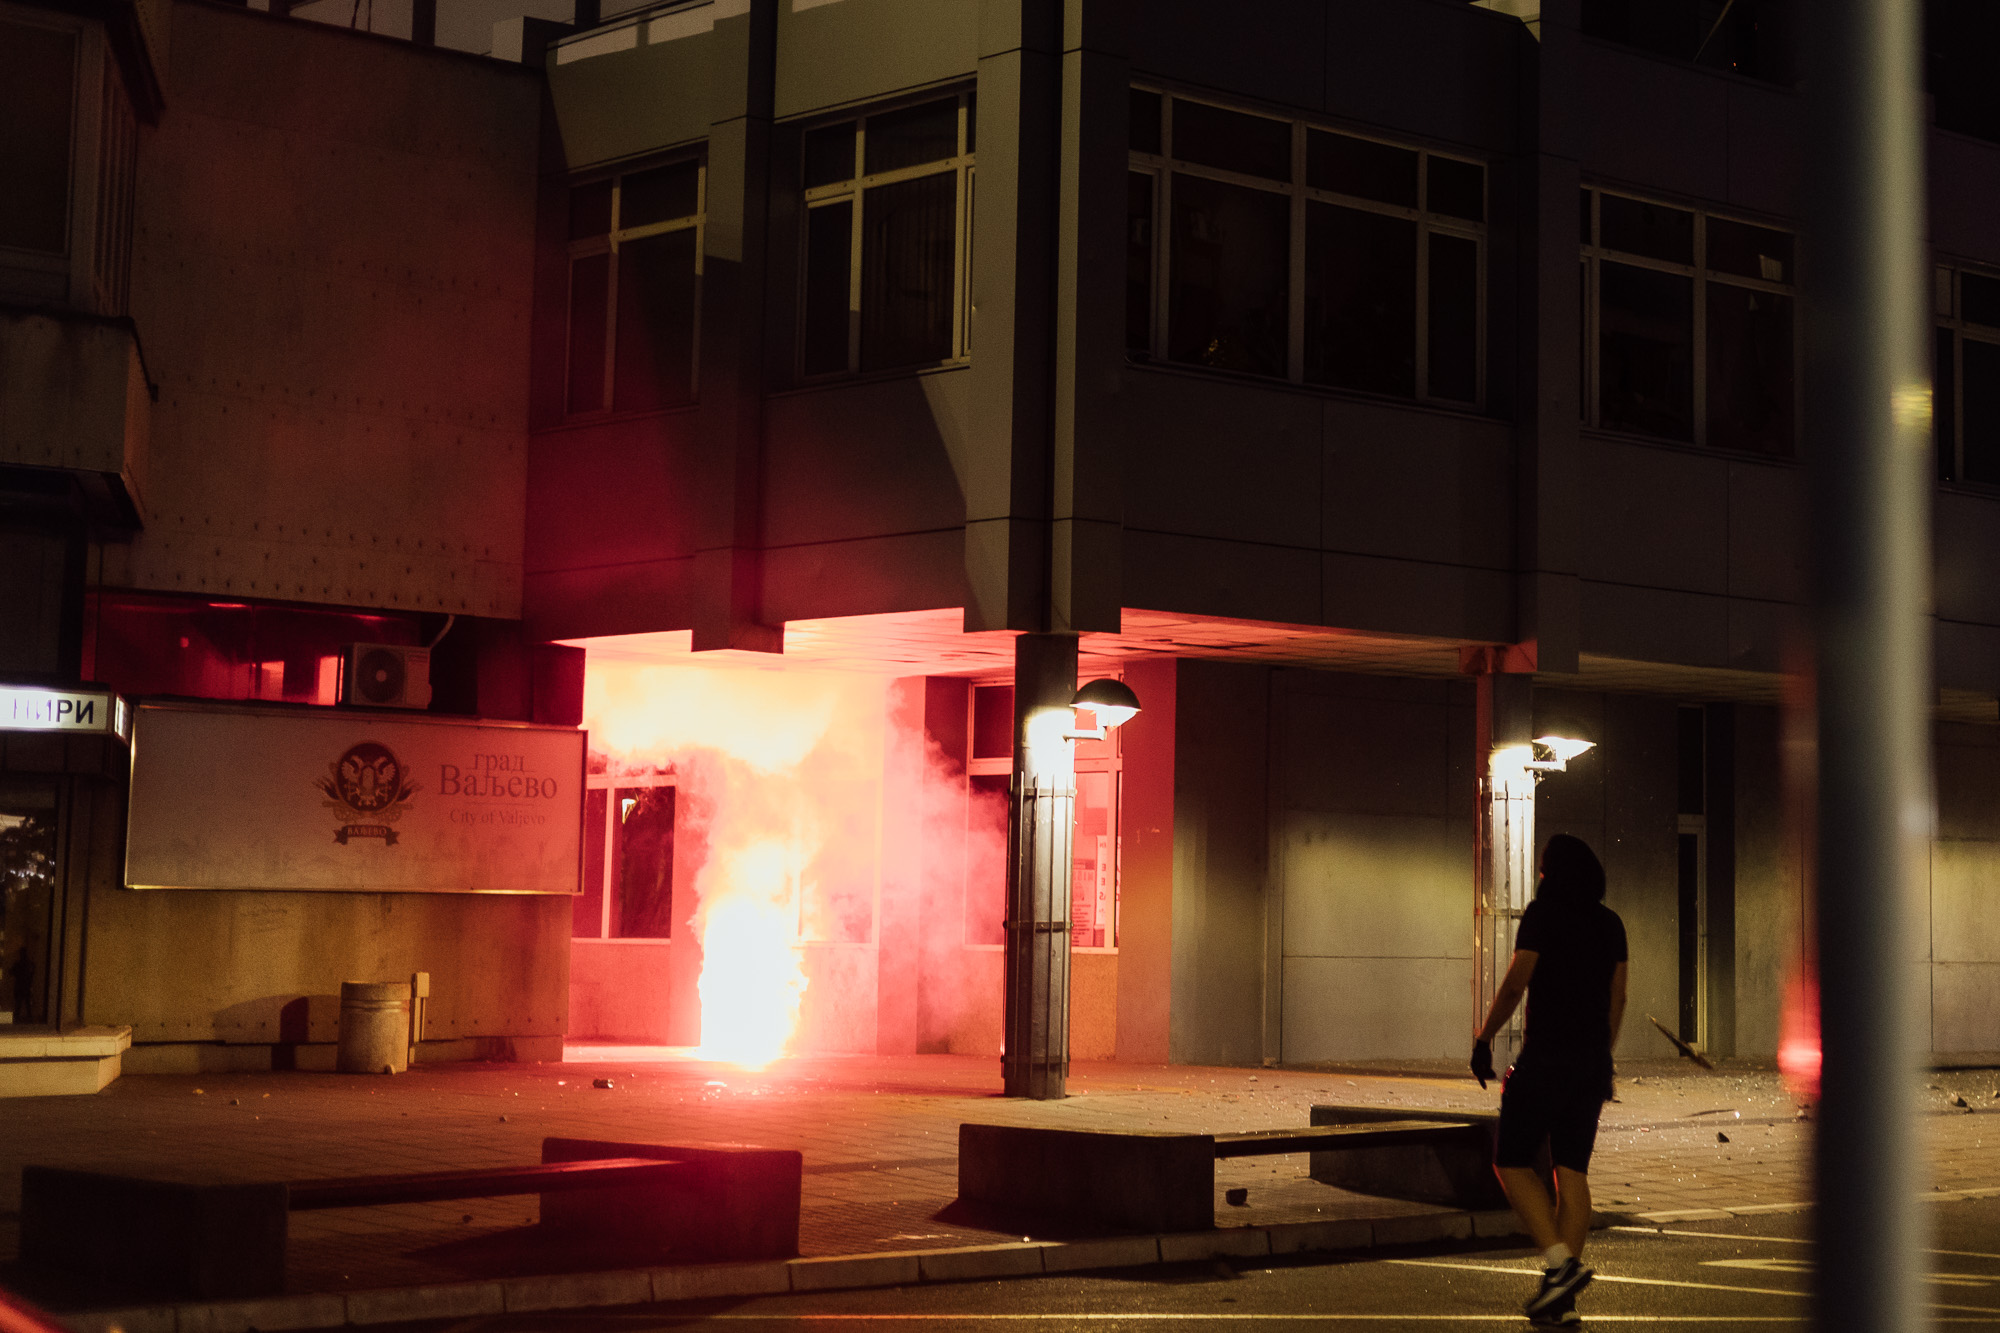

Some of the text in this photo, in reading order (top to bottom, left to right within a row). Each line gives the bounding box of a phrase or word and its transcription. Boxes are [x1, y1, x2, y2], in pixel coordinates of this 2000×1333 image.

[474, 753, 525, 777] град
[439, 764, 558, 799] Ваљево
[450, 808, 546, 827] City of Valjevo
